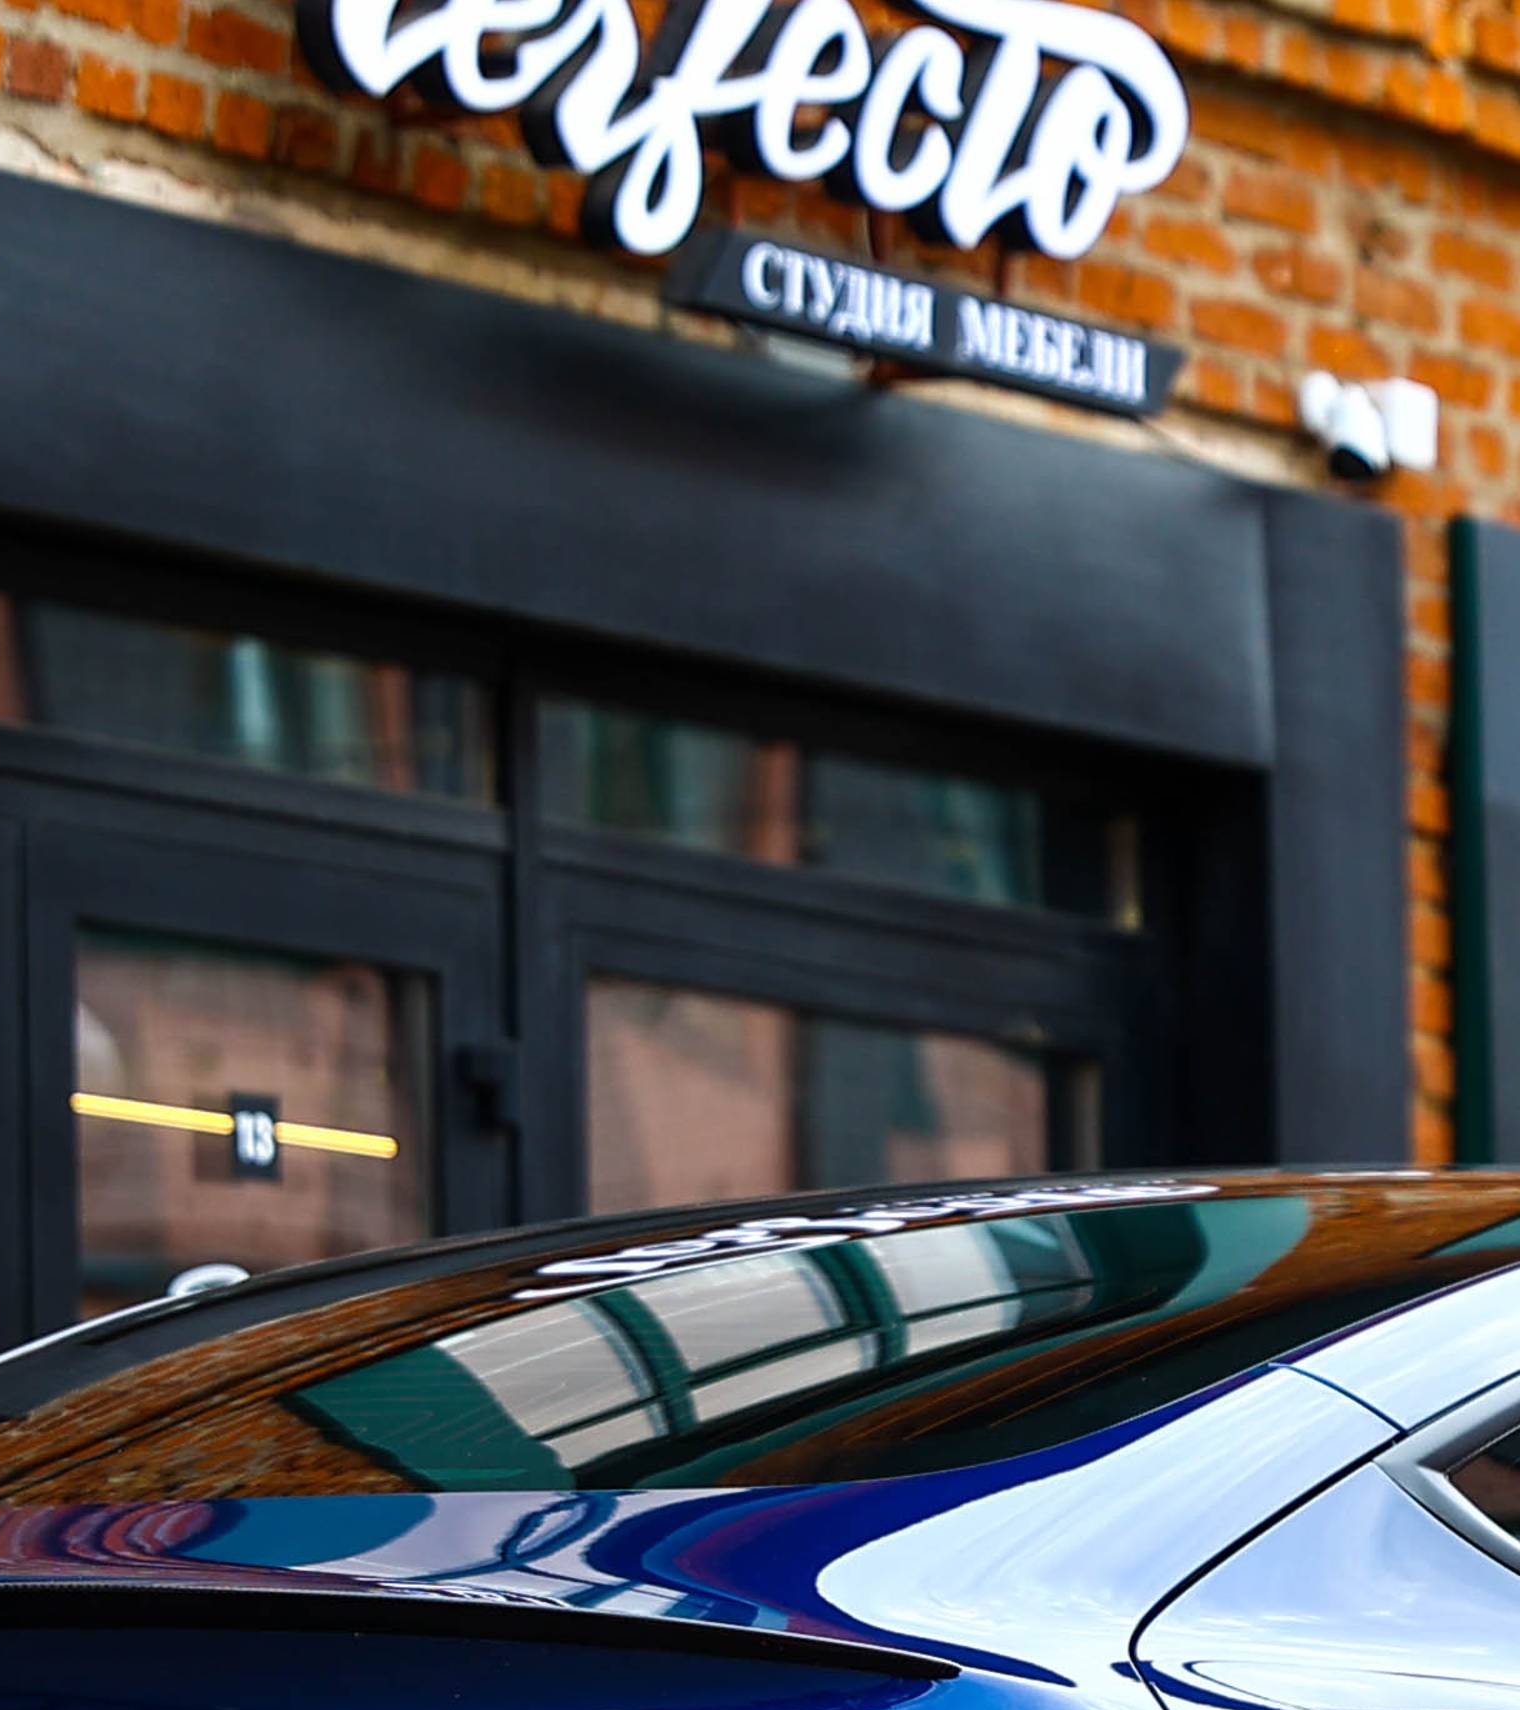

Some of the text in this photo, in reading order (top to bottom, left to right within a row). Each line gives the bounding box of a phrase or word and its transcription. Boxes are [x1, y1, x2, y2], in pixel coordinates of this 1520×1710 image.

[332, 0, 1190, 260] erfecto
[741, 241, 1148, 401] СТУДИЯ МЕБЕЛИ
